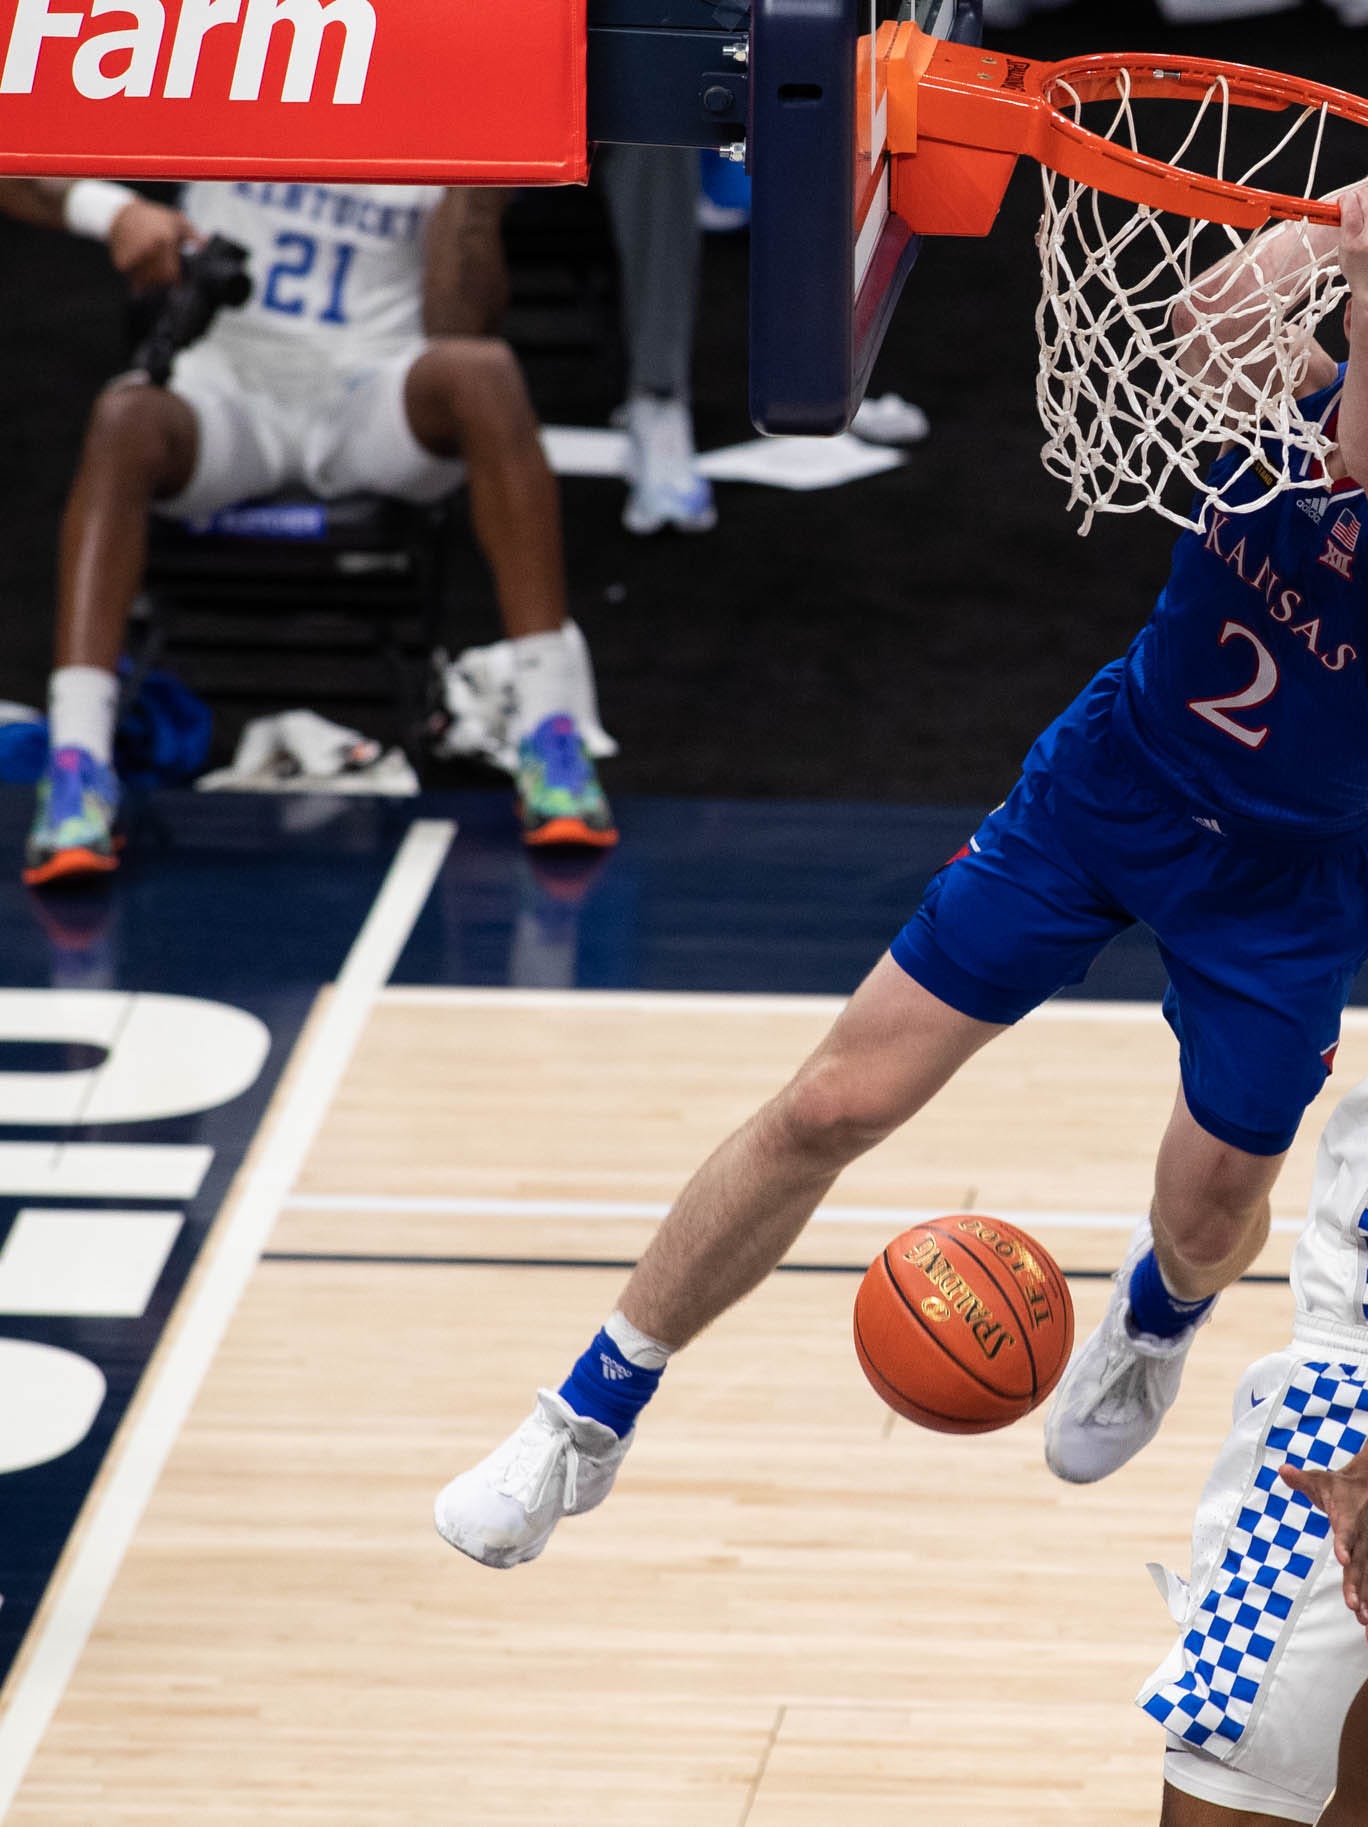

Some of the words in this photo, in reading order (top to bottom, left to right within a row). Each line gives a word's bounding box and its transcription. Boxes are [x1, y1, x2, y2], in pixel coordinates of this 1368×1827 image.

[0, 0, 377, 105] Farm
[263, 230, 356, 325] 21
[1296, 499, 1322, 526] adida
[1203, 509, 1357, 672] KANSAS
[1187, 619, 1280, 750] 2
[903, 1232, 1017, 1360] SPALDING
